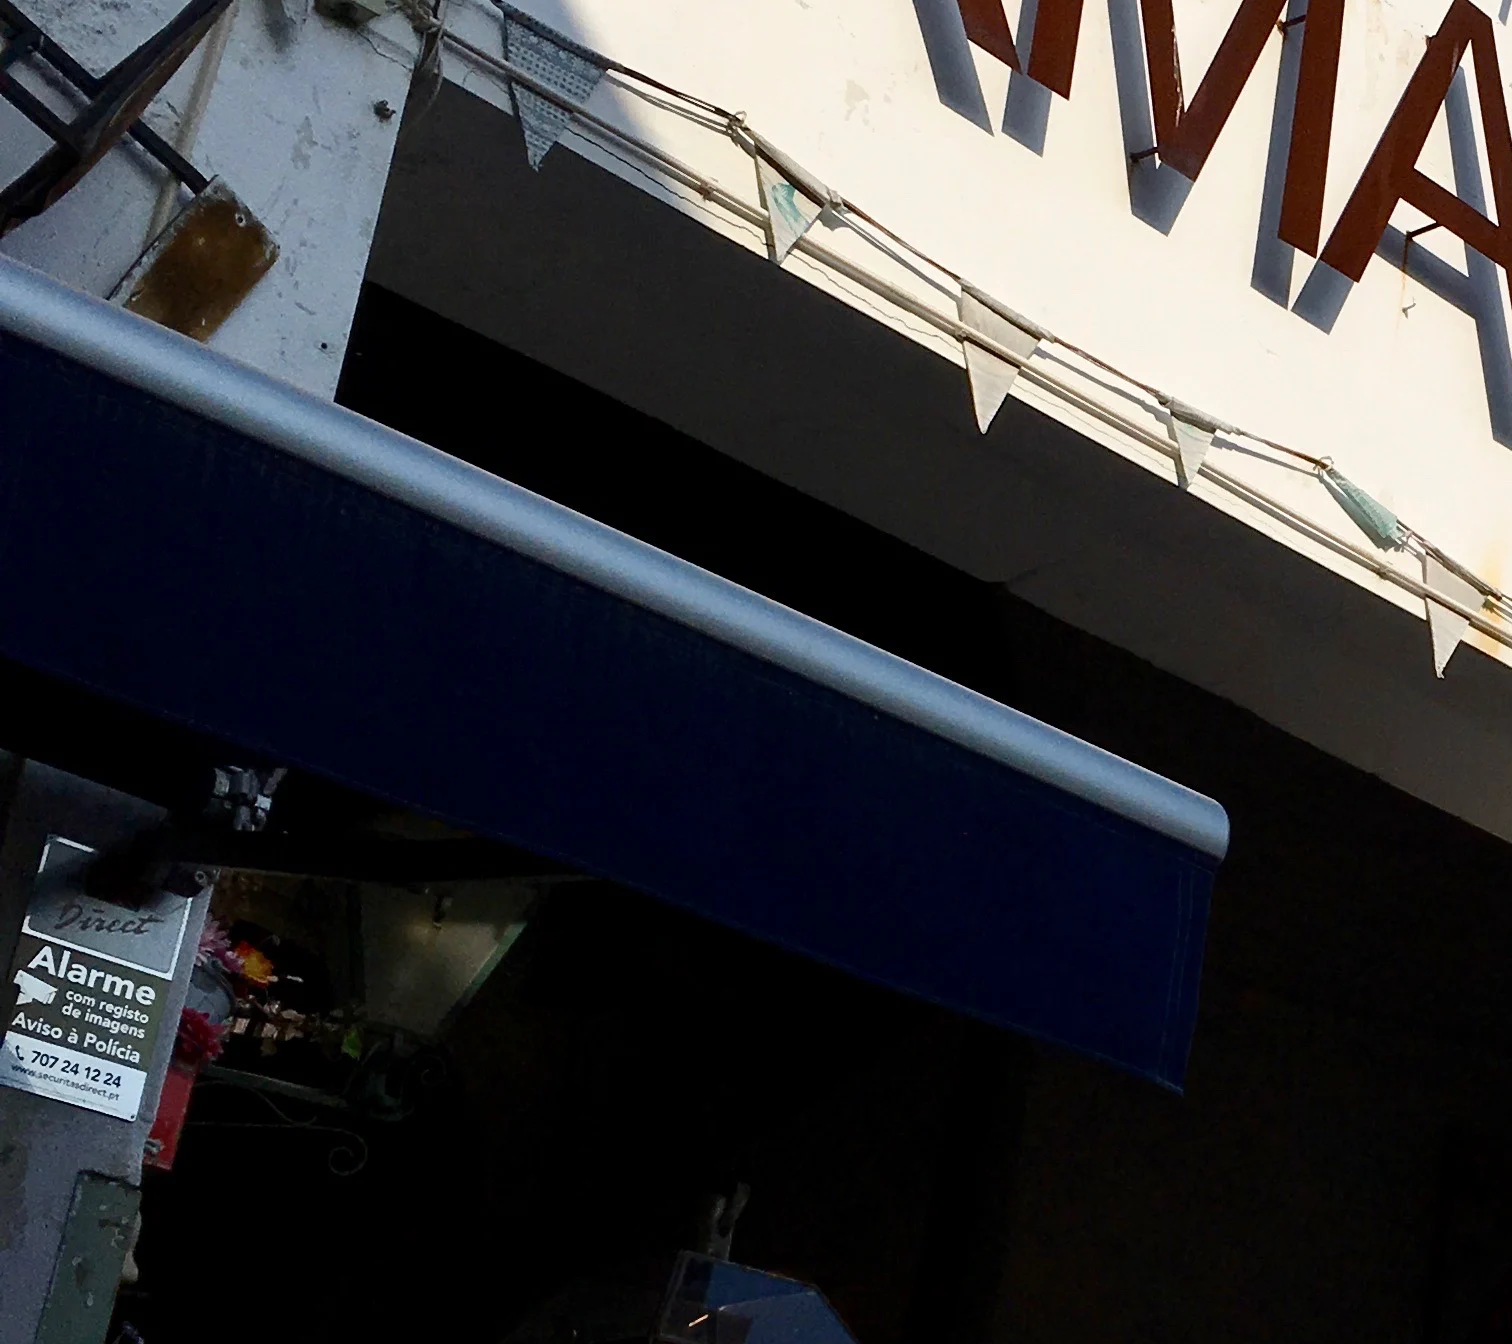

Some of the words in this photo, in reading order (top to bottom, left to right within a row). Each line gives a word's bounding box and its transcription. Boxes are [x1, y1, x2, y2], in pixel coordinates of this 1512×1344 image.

[54, 902, 164, 935] Direct
[28, 945, 156, 1005] Alarme
[61, 1003, 82, 1019] de
[84, 1009, 146, 1039] imagens
[65, 989, 96, 1007] com
[99, 999, 149, 1025] registo
[12, 1011, 61, 1040] Aviso
[67, 1028, 79, 1044] à
[83, 1032, 140, 1065] Polícia
[31, 1050, 59, 1069] 707
[61, 1060, 79, 1076] 24
[84, 1066, 101, 1082] 12
[103, 1072, 122, 1088] 24
